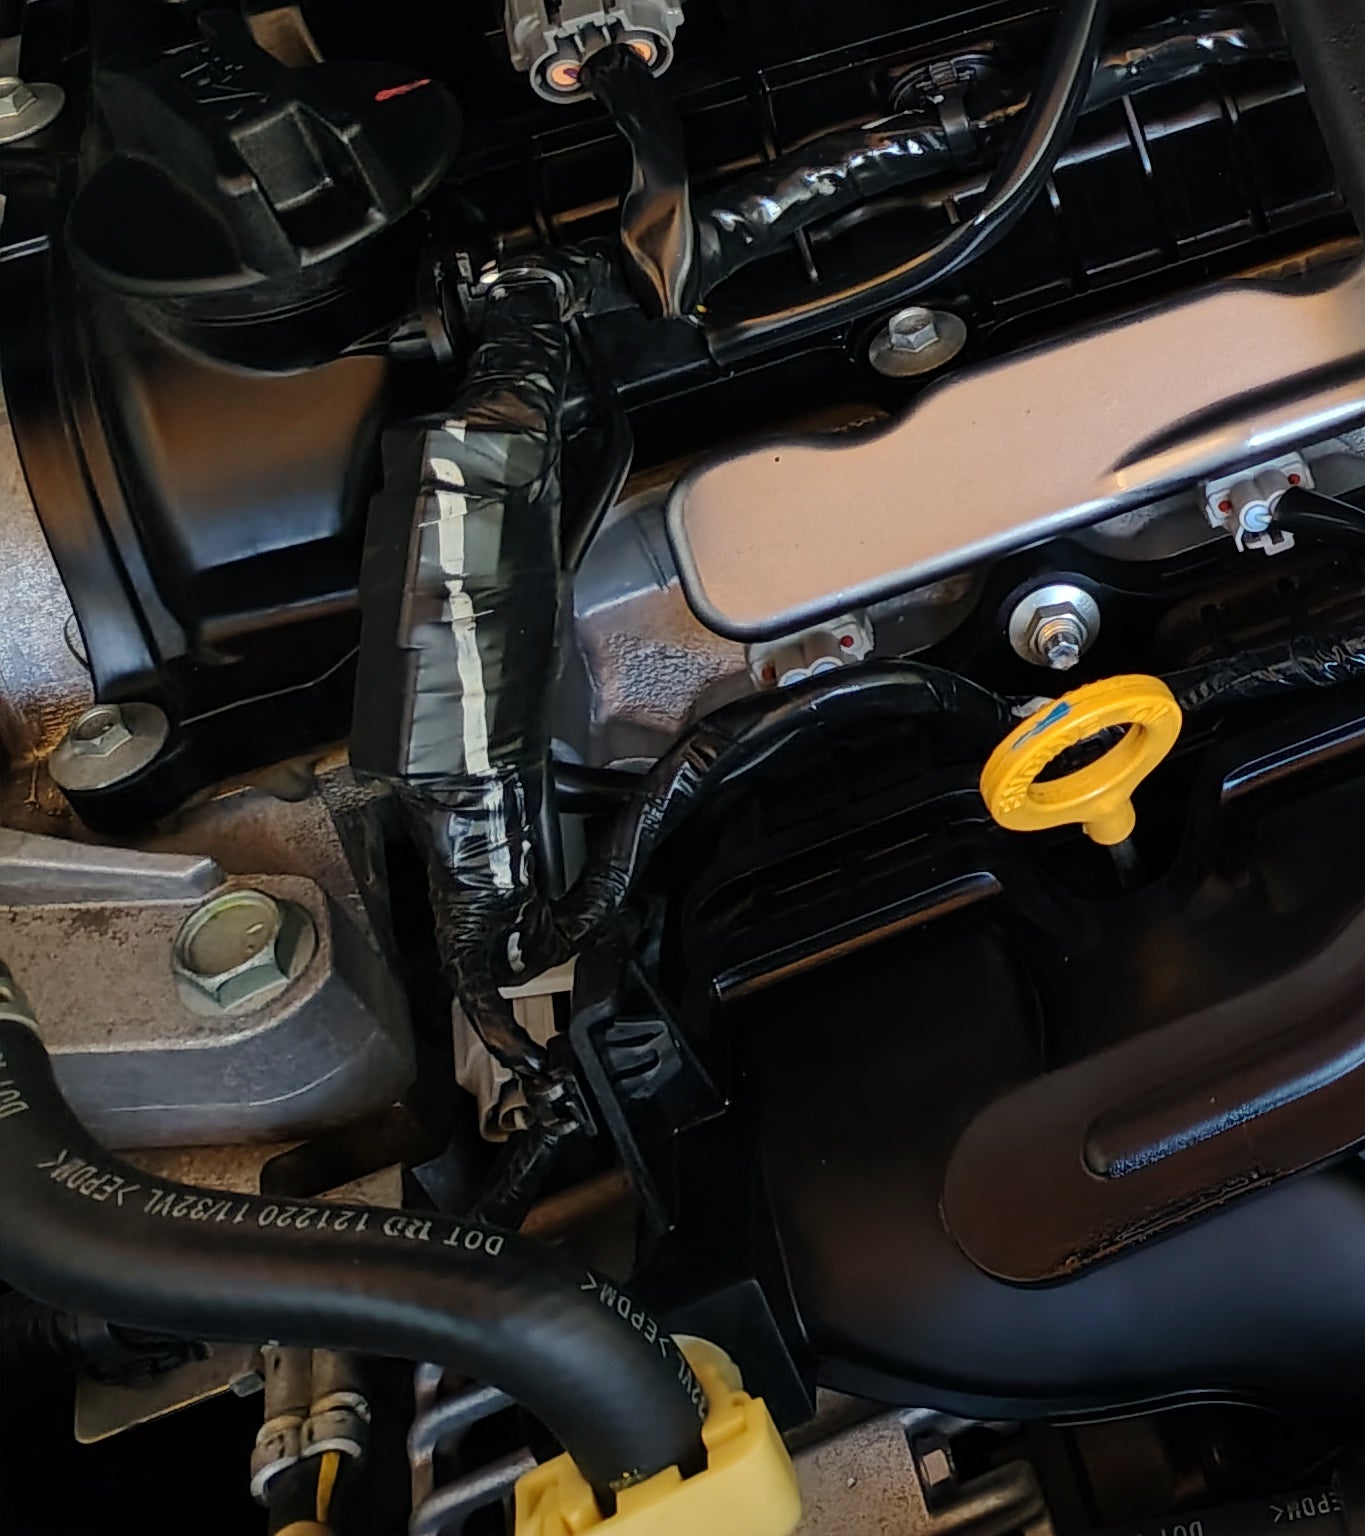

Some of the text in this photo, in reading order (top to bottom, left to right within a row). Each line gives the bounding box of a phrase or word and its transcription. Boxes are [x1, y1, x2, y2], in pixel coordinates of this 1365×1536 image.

[142, 1186, 249, 1228] 11/32VL
[257, 1202, 372, 1235] 121220
[442, 1223, 506, 1258] DOT
[579, 1268, 672, 1359] >EPDM<
